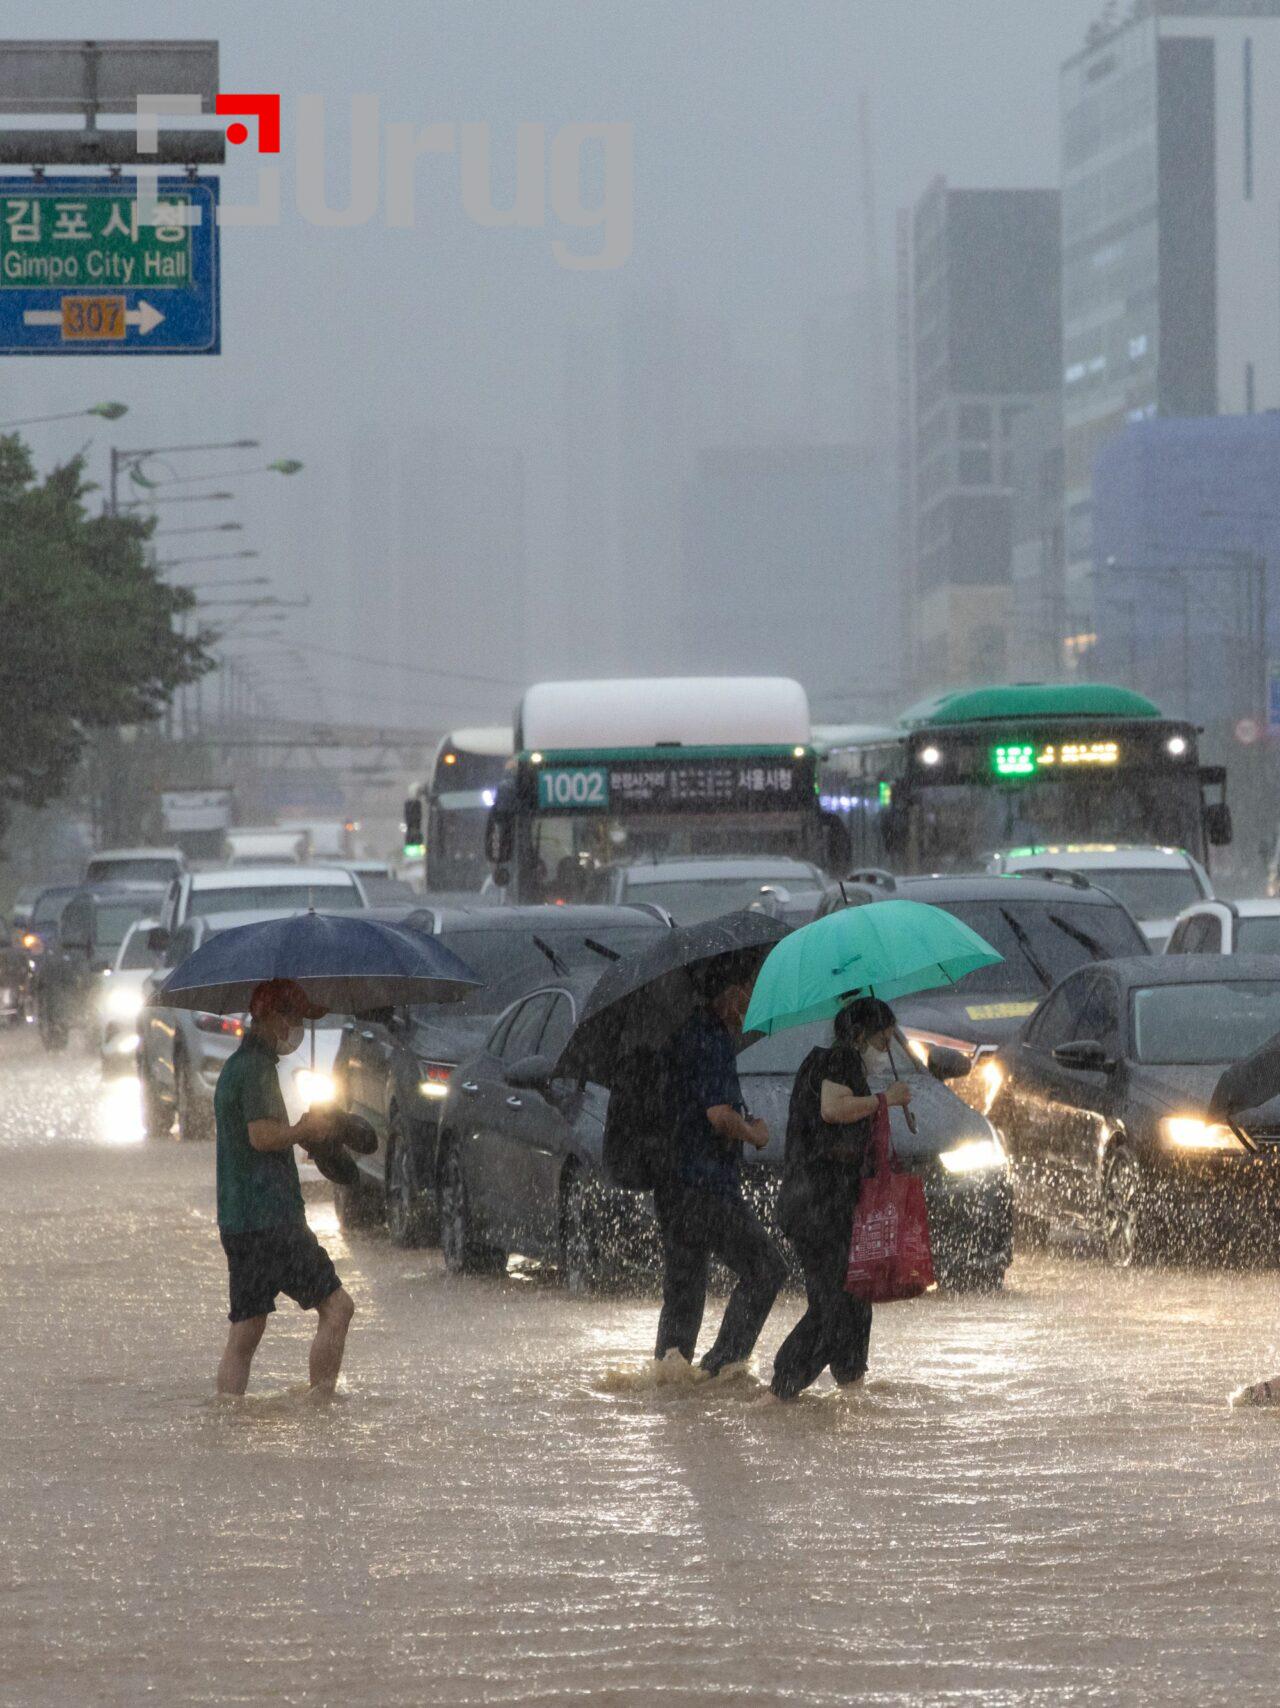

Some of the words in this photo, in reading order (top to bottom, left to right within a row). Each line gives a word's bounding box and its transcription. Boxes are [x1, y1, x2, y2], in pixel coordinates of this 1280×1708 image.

[6, 201, 187, 243] 김포시청
[4, 250, 79, 280] Gimpo
[86, 250, 136, 284] City
[145, 250, 187, 277] Hall
[67, 302, 122, 335] 307
[543, 773, 605, 804] 1002
[737, 769, 793, 792] 서울시청
